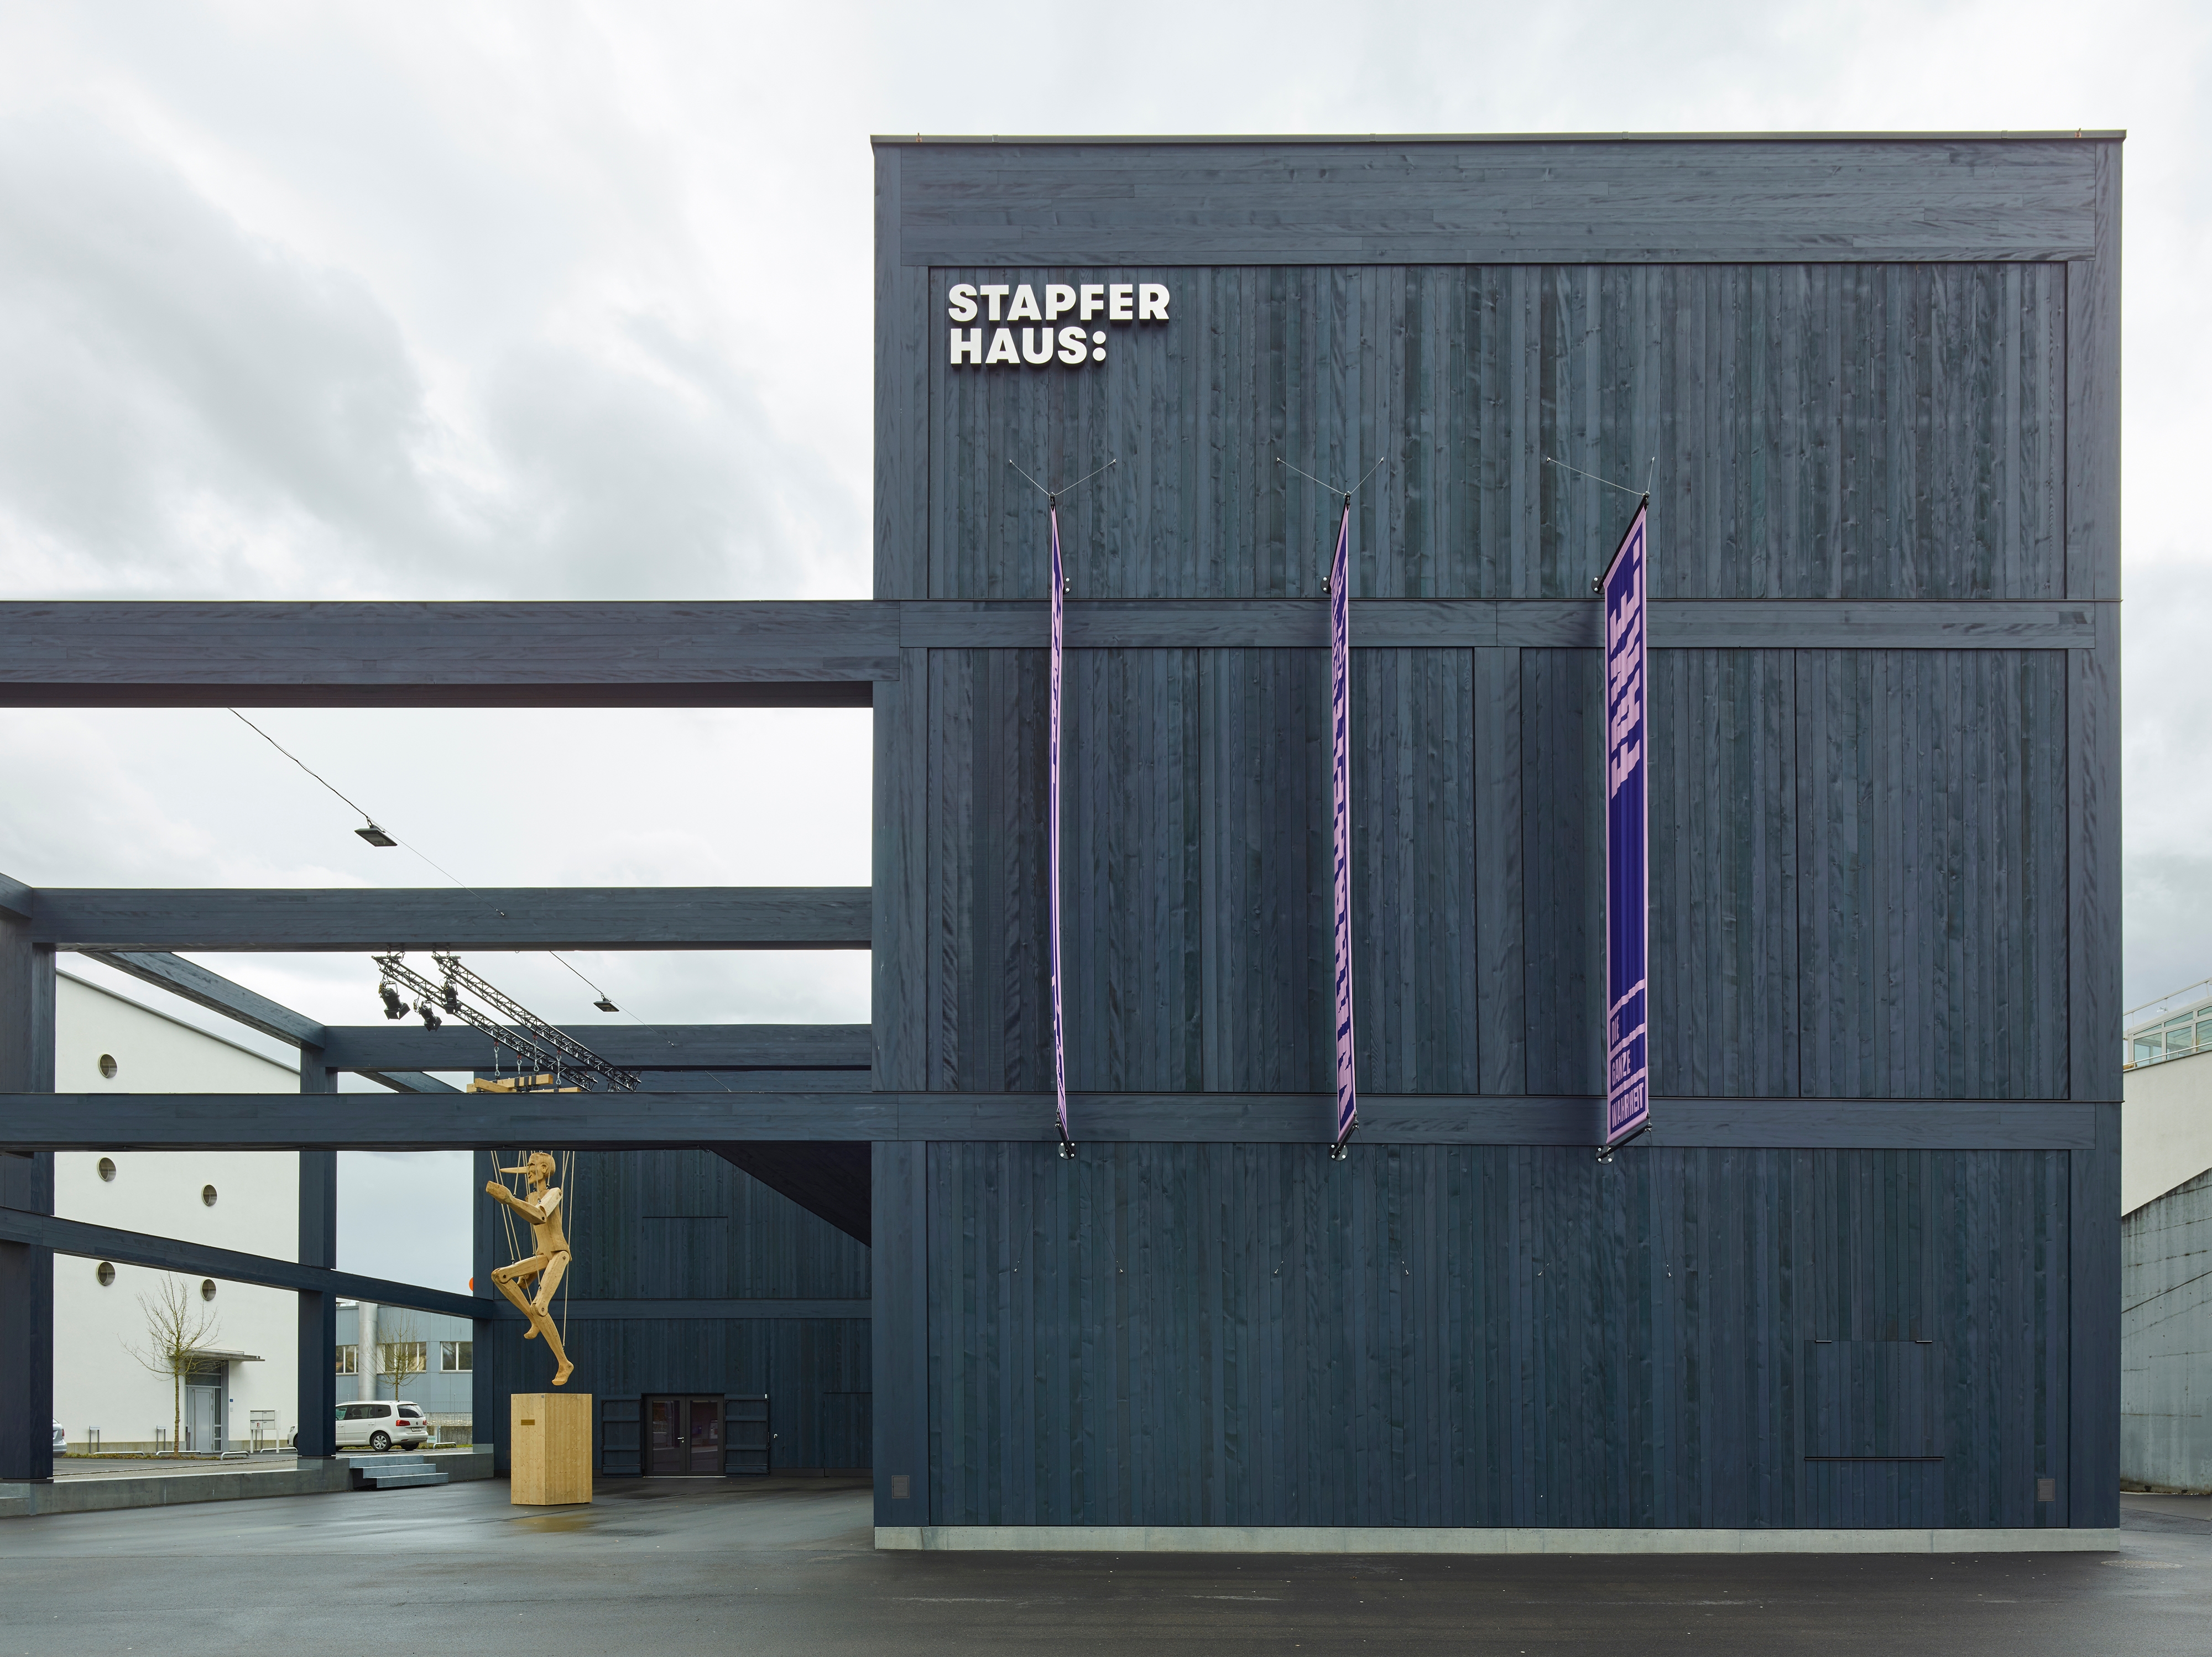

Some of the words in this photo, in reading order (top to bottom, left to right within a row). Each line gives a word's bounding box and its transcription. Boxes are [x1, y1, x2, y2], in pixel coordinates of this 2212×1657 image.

[948, 284, 1170, 322] STAPFER
[951, 327, 1106, 364] HAUS:
[1610, 535, 1640, 800] FAKE.
[1611, 1014, 1620, 1046] DIE
[1611, 1048, 1631, 1086] GANZE
[1611, 1081, 1644, 1129] WAHRHEIT
